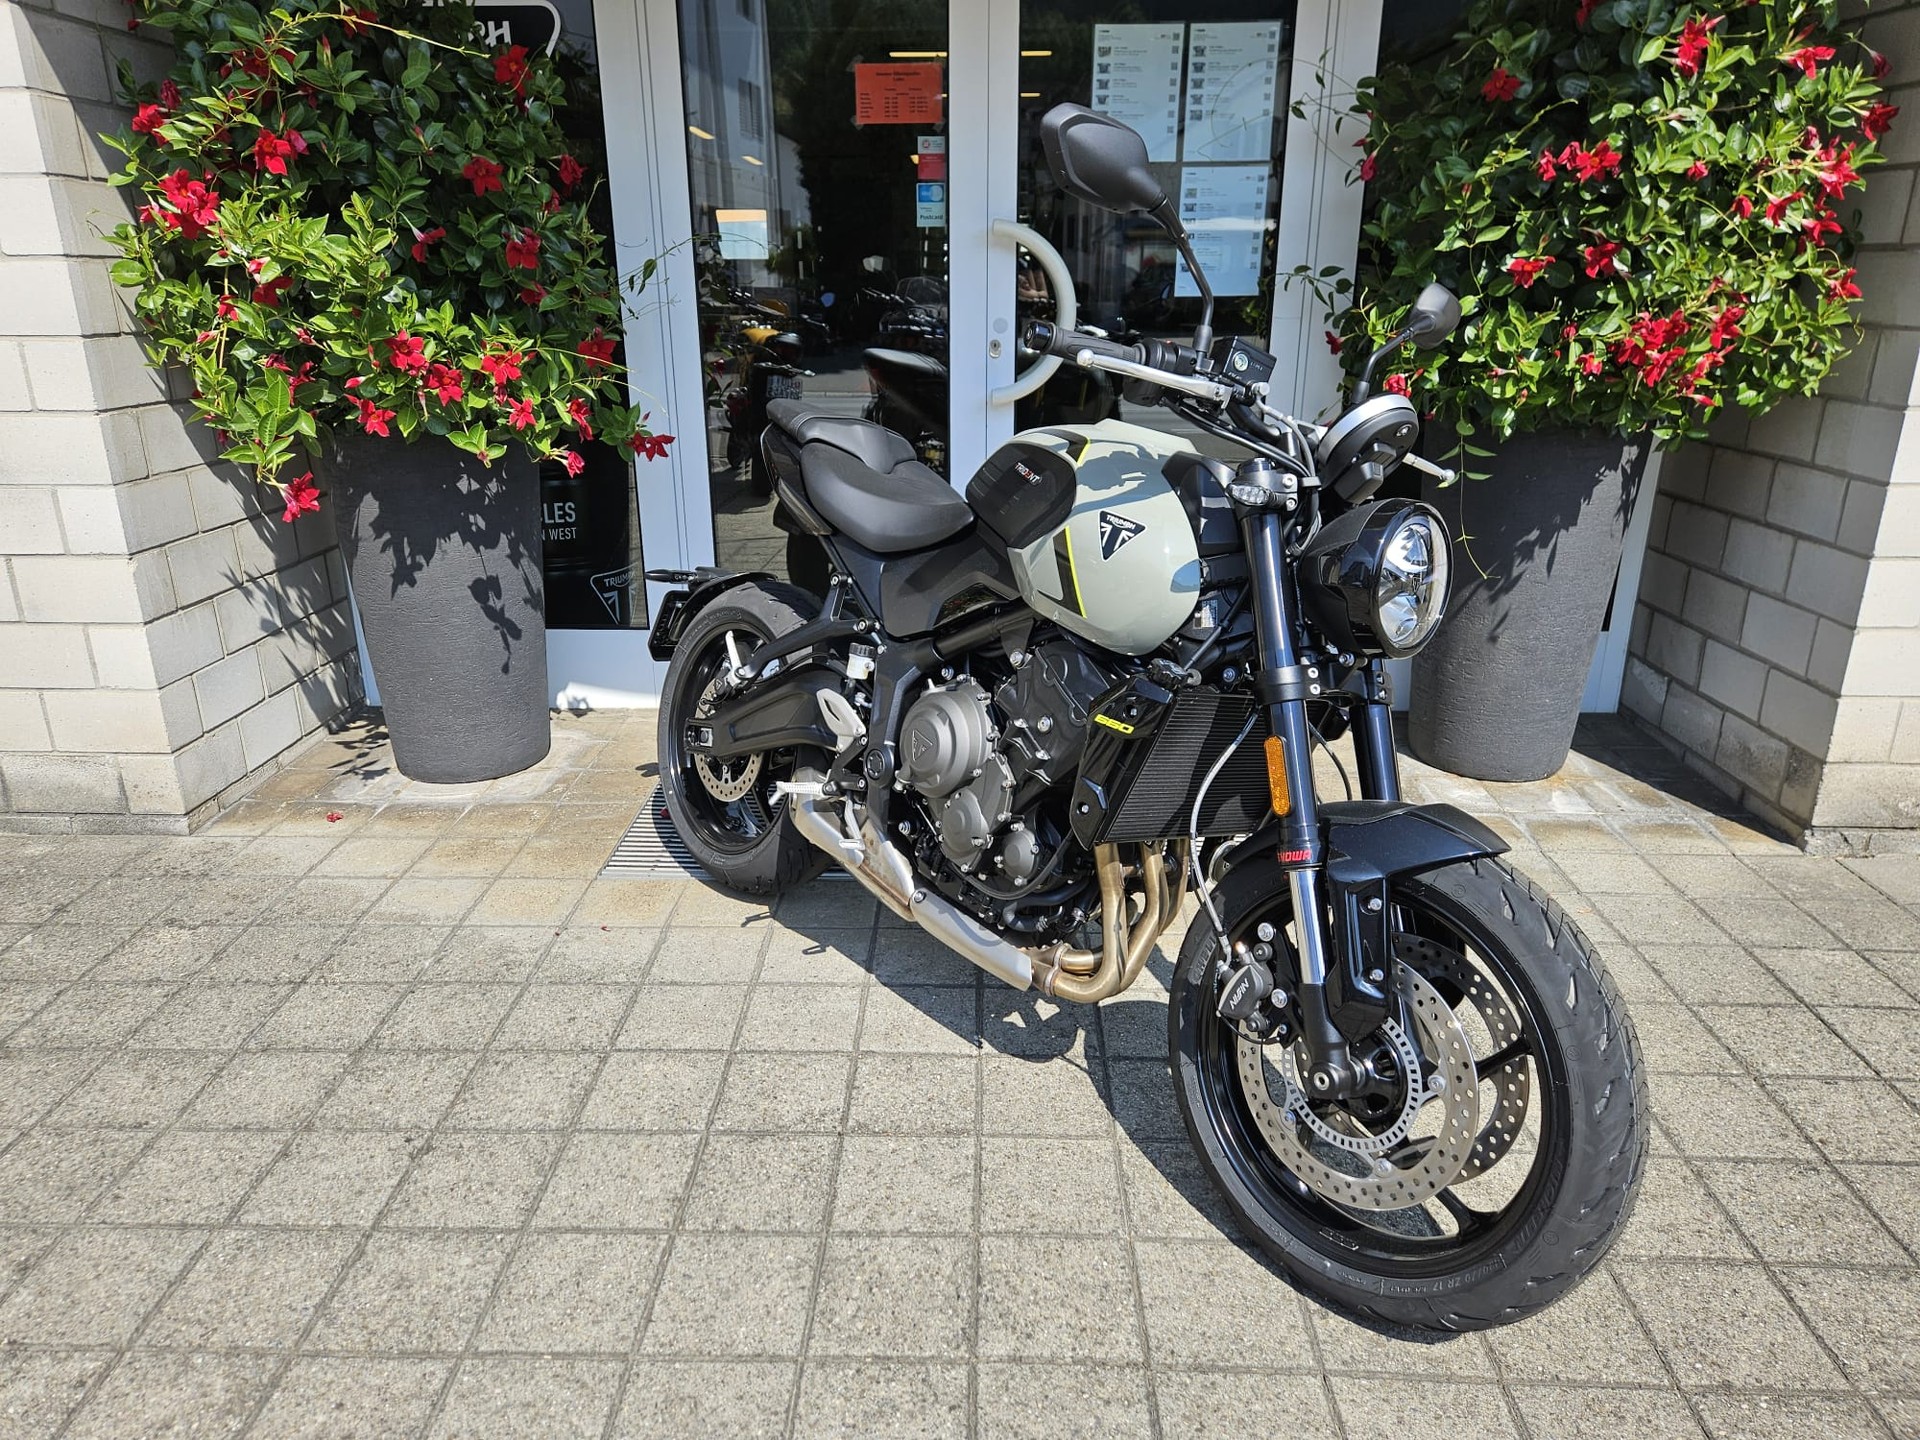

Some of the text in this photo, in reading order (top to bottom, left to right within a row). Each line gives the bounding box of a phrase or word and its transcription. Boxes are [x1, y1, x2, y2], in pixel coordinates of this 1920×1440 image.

[1015, 462, 1041, 484] TRIDENT
[541, 502, 576, 523] LES
[1106, 514, 1136, 530] TRIUMPH
[549, 527, 577, 540] WEST
[1094, 713, 1135, 735] 660
[1277, 850, 1312, 863] HOWA
